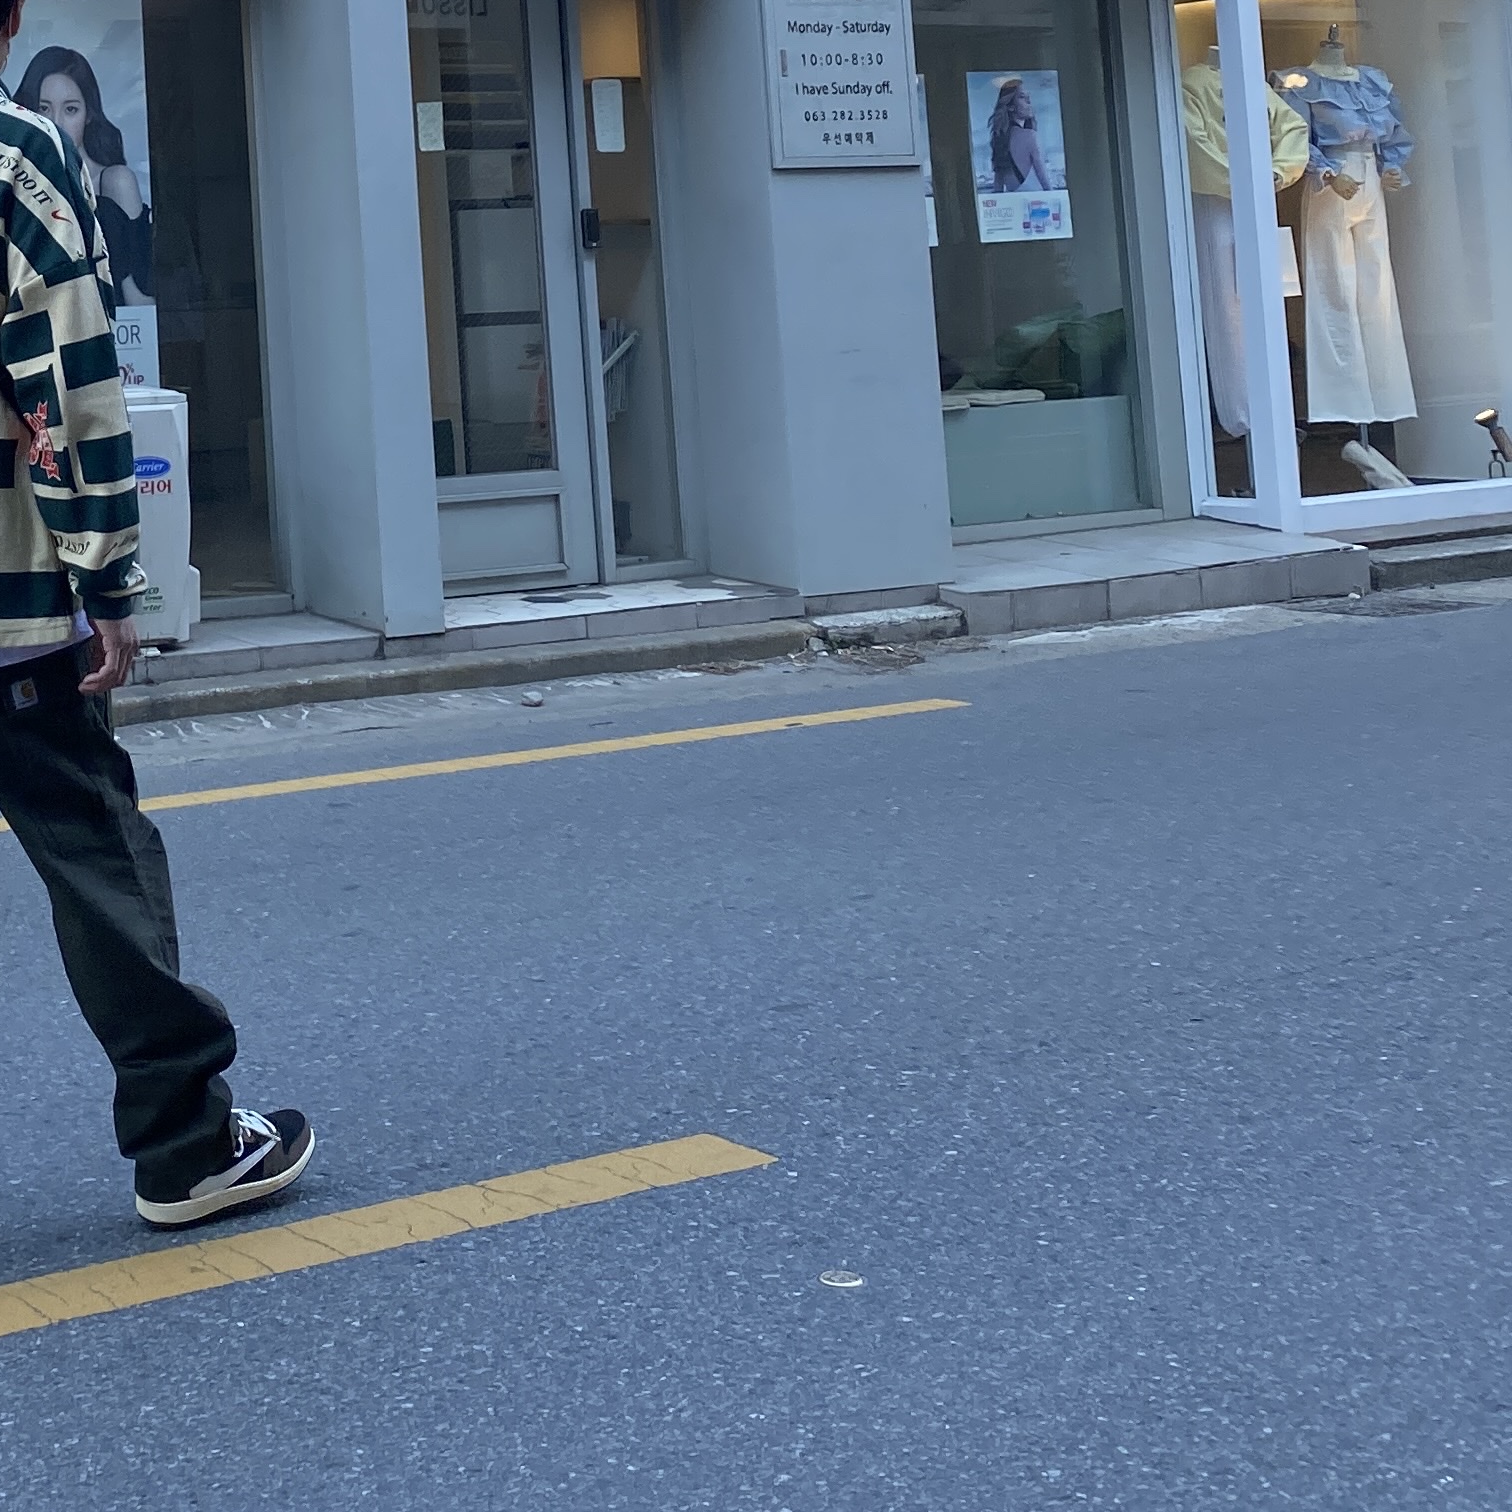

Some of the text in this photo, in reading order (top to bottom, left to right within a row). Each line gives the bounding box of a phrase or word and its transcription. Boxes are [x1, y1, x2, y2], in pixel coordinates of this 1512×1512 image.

[801, 53, 883, 66] 10:00-8:30
[795, 81, 893, 97] I have Sunday off.
[14, 170, 37, 190] DO
[32, 189, 53, 205] IT
[136, 480, 172, 495] 리어
